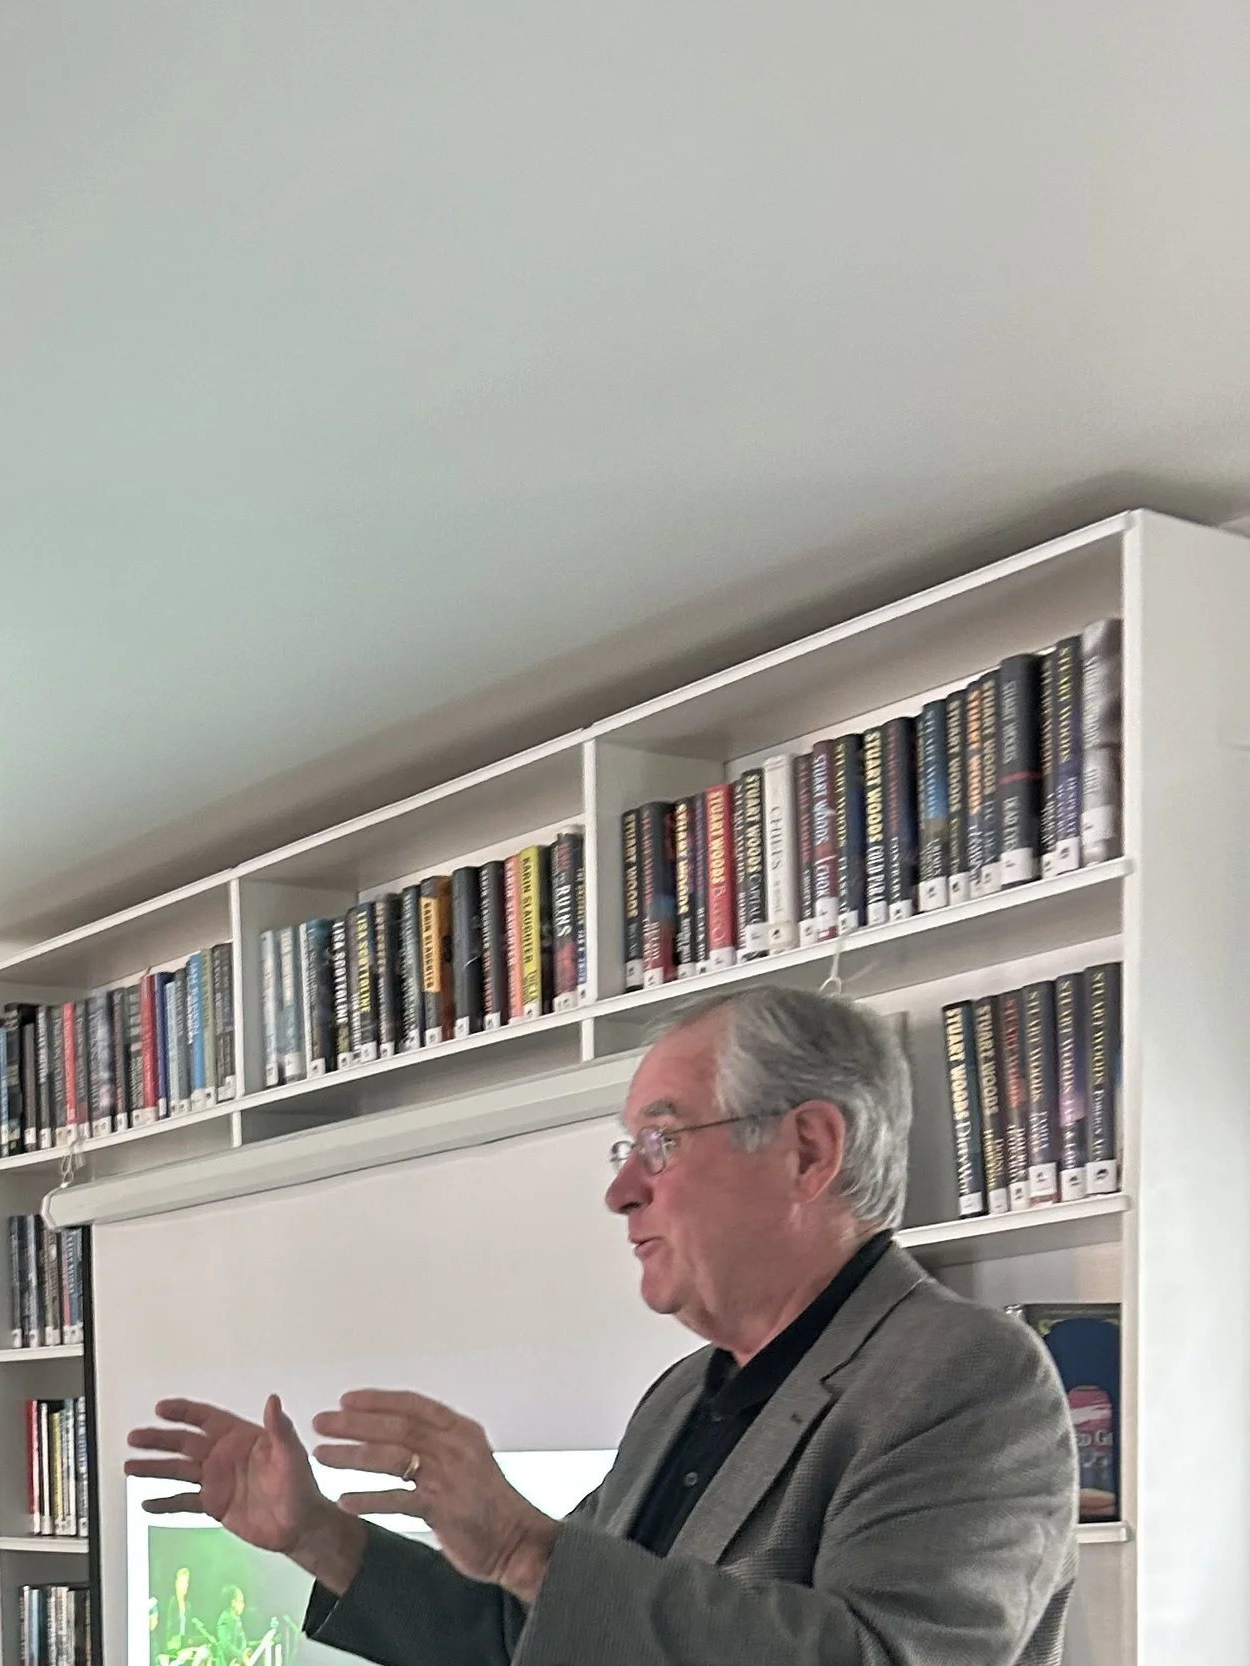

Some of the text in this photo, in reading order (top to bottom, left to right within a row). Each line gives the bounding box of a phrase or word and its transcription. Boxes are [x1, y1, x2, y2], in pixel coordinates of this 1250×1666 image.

[946, 700, 961, 753] STUART
[1058, 648, 1071, 764] STUART WOODS
[866, 731, 880, 786] STUART
[982, 681, 996, 795] STUART WOODS
[745, 775, 761, 825] STUART
[949, 757, 961, 813] WOODS
[969, 755, 982, 815] WOODS
[622, 814, 637, 864] STUART
[708, 791, 725, 836] STUART
[813, 754, 830, 898] STUART WOODS CHOK
[868, 787, 883, 842] WOODS
[522, 857, 533, 893] KARIN
[709, 838, 725, 885] WOODS
[747, 826, 762, 873] WOODS
[556, 885, 572, 937] RUINS
[626, 866, 638, 919] WOODS
[523, 898, 534, 964] SLAUGHTER
[334, 952, 347, 1025] SCOTTOLINE
[358, 942, 370, 1013] SCOTTOLINE
[1090, 972, 1105, 1028] STUART
[946, 1009, 965, 1061] STUART
[1058, 981, 1072, 1035] STUART
[977, 1005, 997, 1116] STUART WOODS
[1026, 991, 1041, 1102] STUART WOODS
[1061, 1039, 1074, 1094] WOODS
[1094, 1032, 1107, 1085] WOODS
[949, 1064, 969, 1120] WOODS
